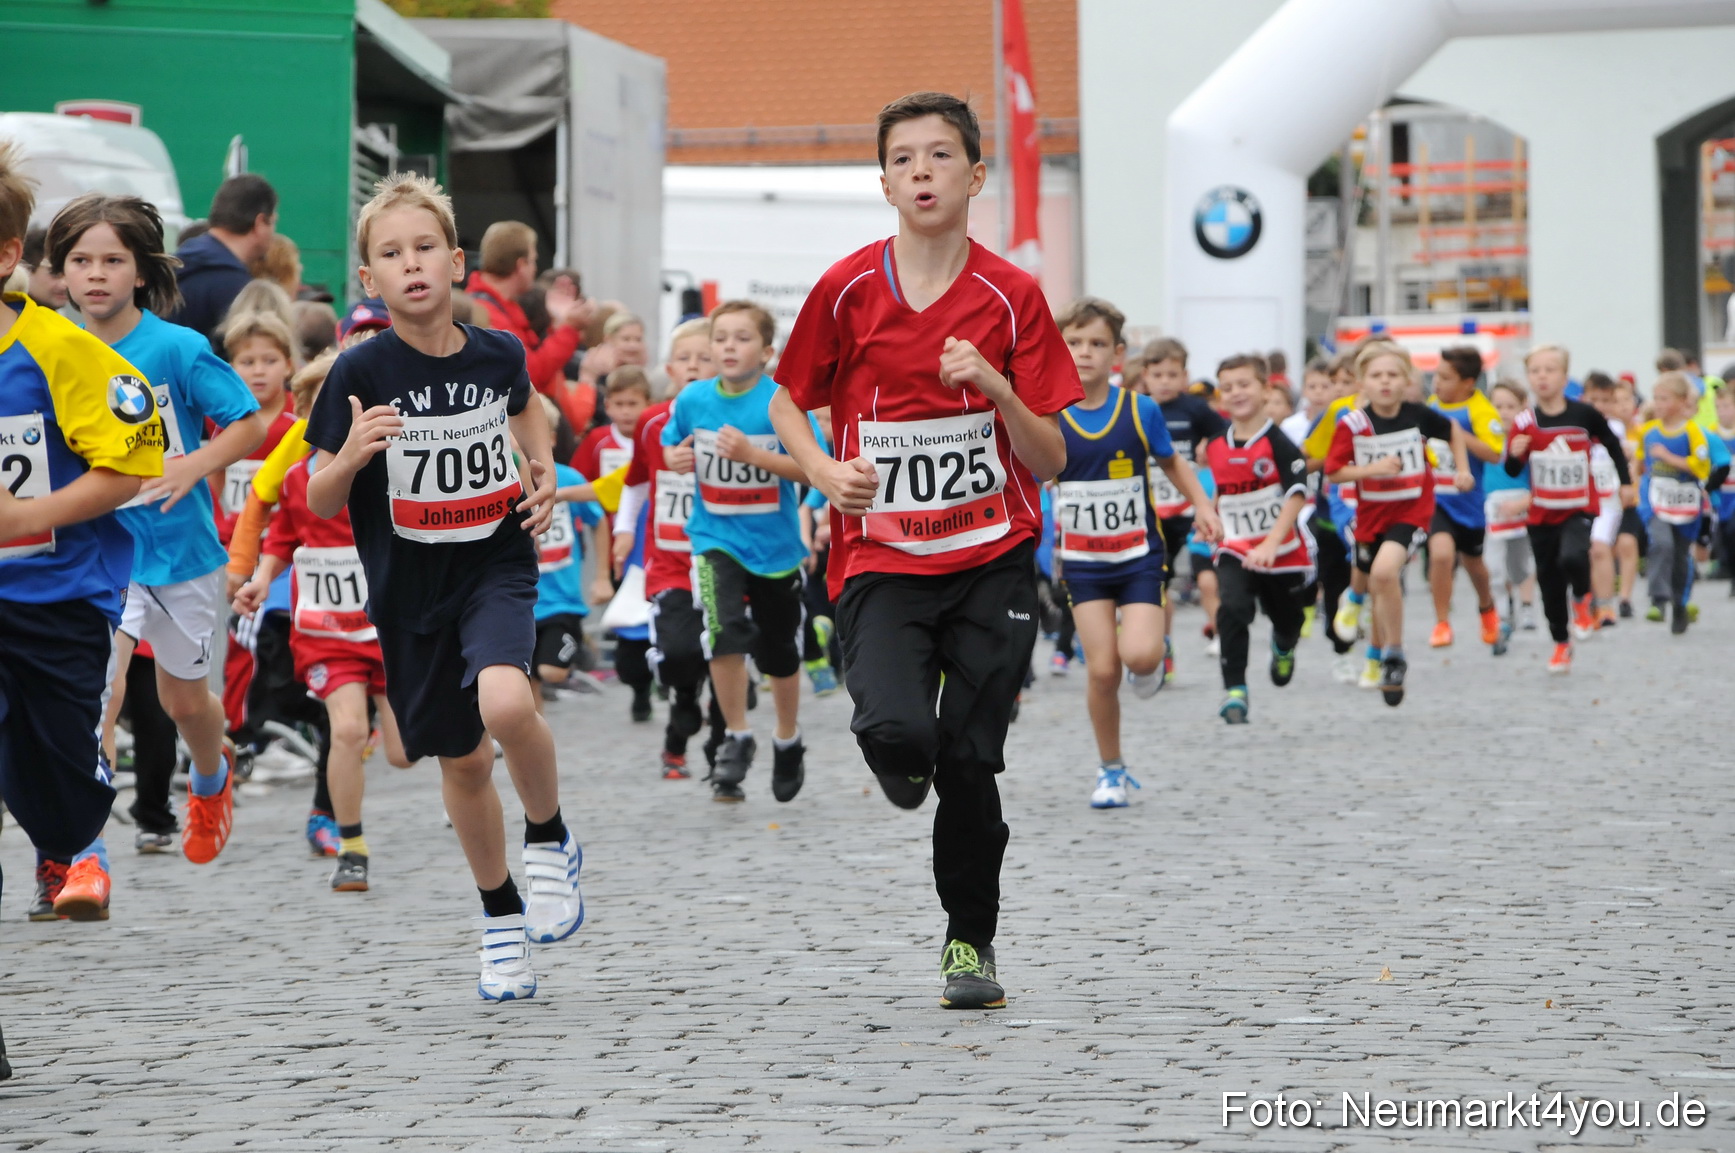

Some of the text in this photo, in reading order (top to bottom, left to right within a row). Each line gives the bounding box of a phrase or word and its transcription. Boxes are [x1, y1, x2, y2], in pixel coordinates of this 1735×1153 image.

[445, 383, 511, 408] YOR
[125, 424, 163, 449] PART
[443, 417, 499, 441] Neumarkt
[863, 429, 978, 448] PARTL Neumarkt
[403, 433, 507, 495] 7093
[875, 447, 996, 504] 7025
[419, 500, 503, 526] Johannes
[899, 510, 974, 537] Valentin
[1066, 499, 1138, 531] 7184
[305, 571, 361, 606] 701
